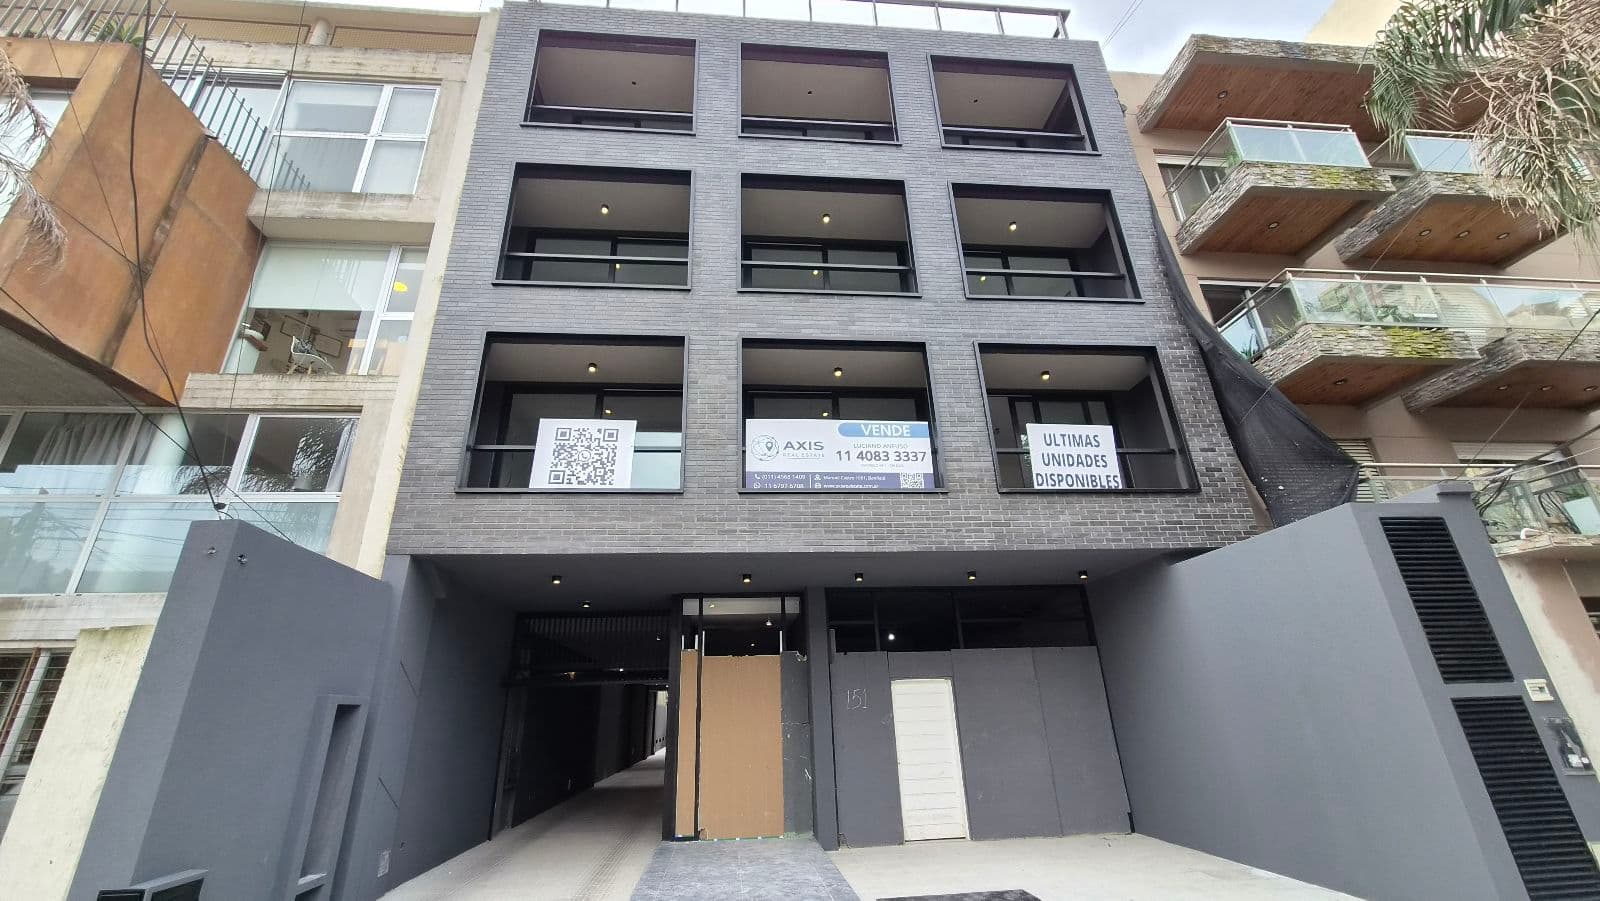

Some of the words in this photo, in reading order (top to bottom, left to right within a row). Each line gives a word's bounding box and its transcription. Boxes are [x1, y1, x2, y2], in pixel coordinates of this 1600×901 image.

[861, 423, 911, 437] VENDE
[783, 441, 825, 451] AXIS
[1043, 432, 1101, 448] ULTIMAS
[836, 450, 851, 462] 11
[856, 450, 890, 462] 4083
[893, 450, 927, 462] 3337
[1041, 452, 1108, 468] UNIDADES
[1035, 472, 1120, 489] DISPONIBLES
[846, 688, 869, 710] 151
